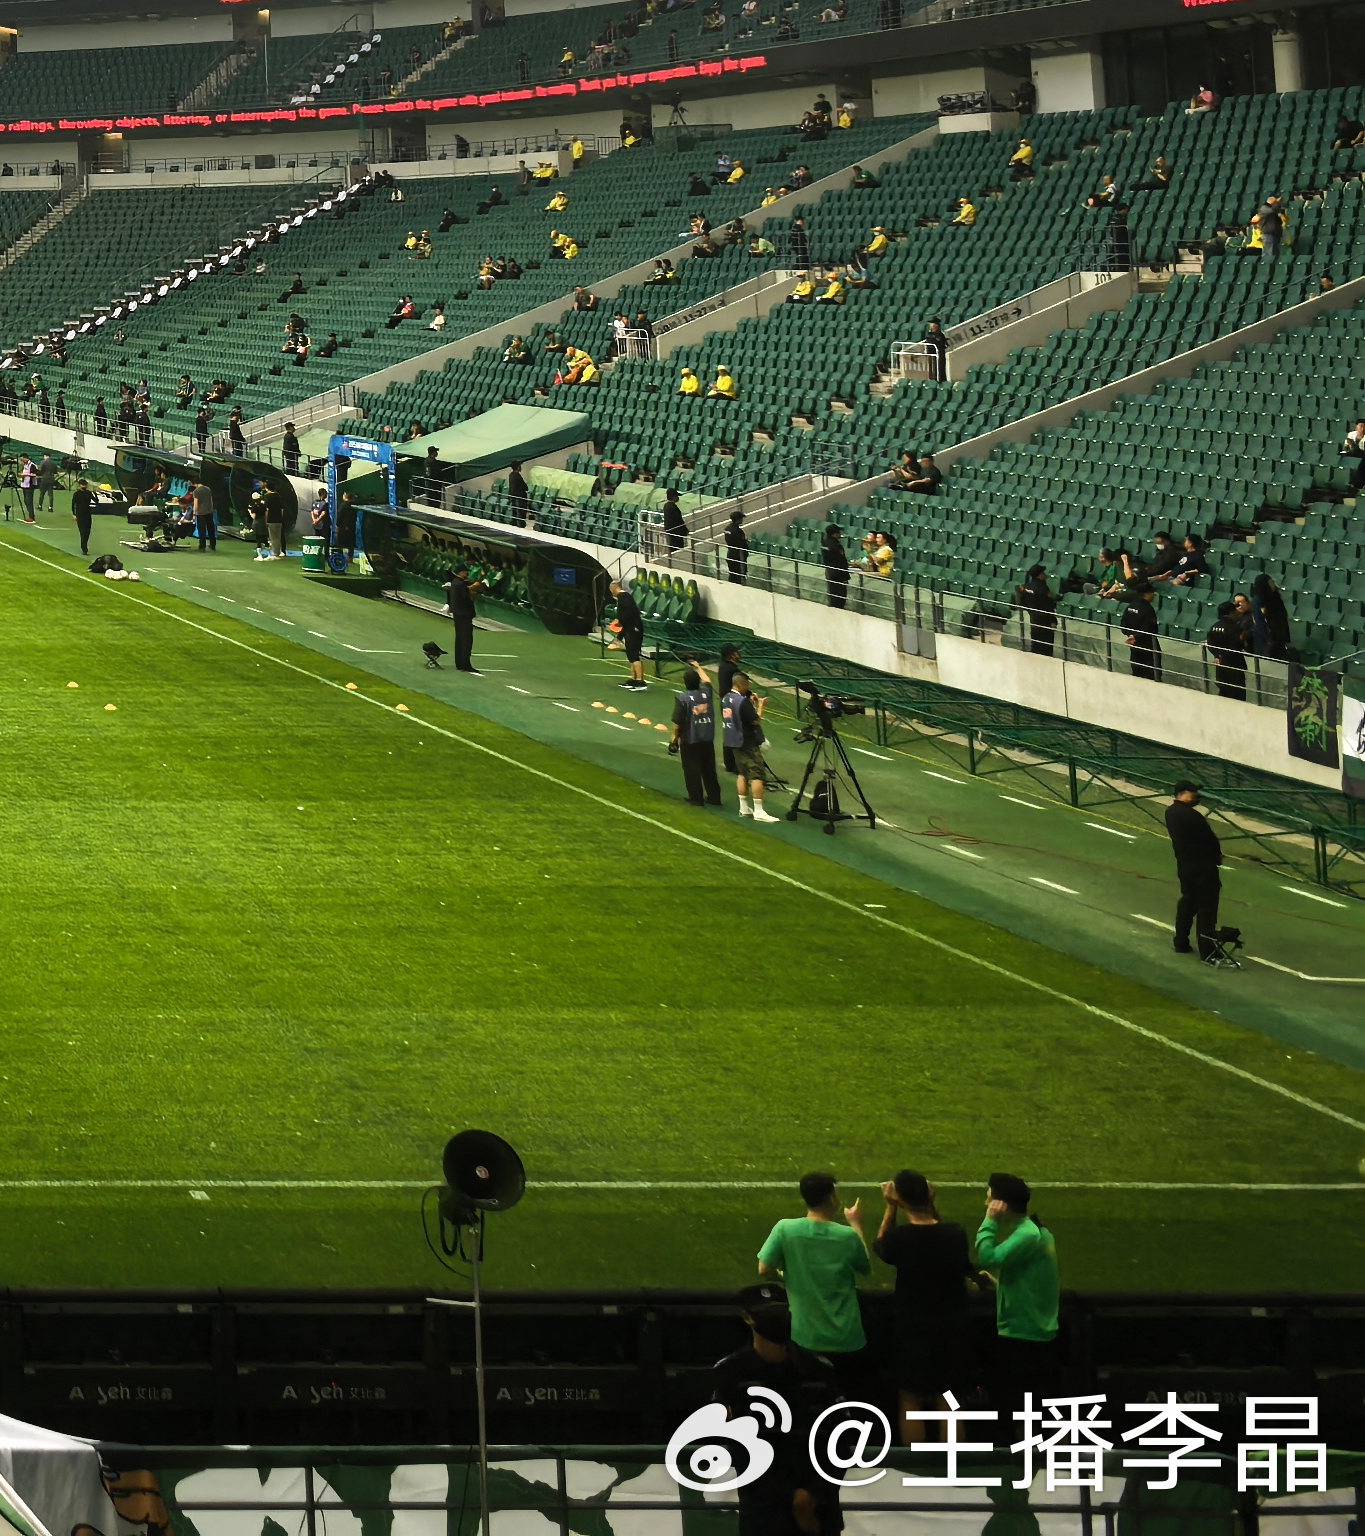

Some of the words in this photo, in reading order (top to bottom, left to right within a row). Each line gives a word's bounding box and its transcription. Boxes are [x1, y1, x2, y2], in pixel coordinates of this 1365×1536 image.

[69, 1382, 130, 1404] Asen
[282, 1382, 343, 1404] Asen
[496, 1384, 557, 1405] Asen
